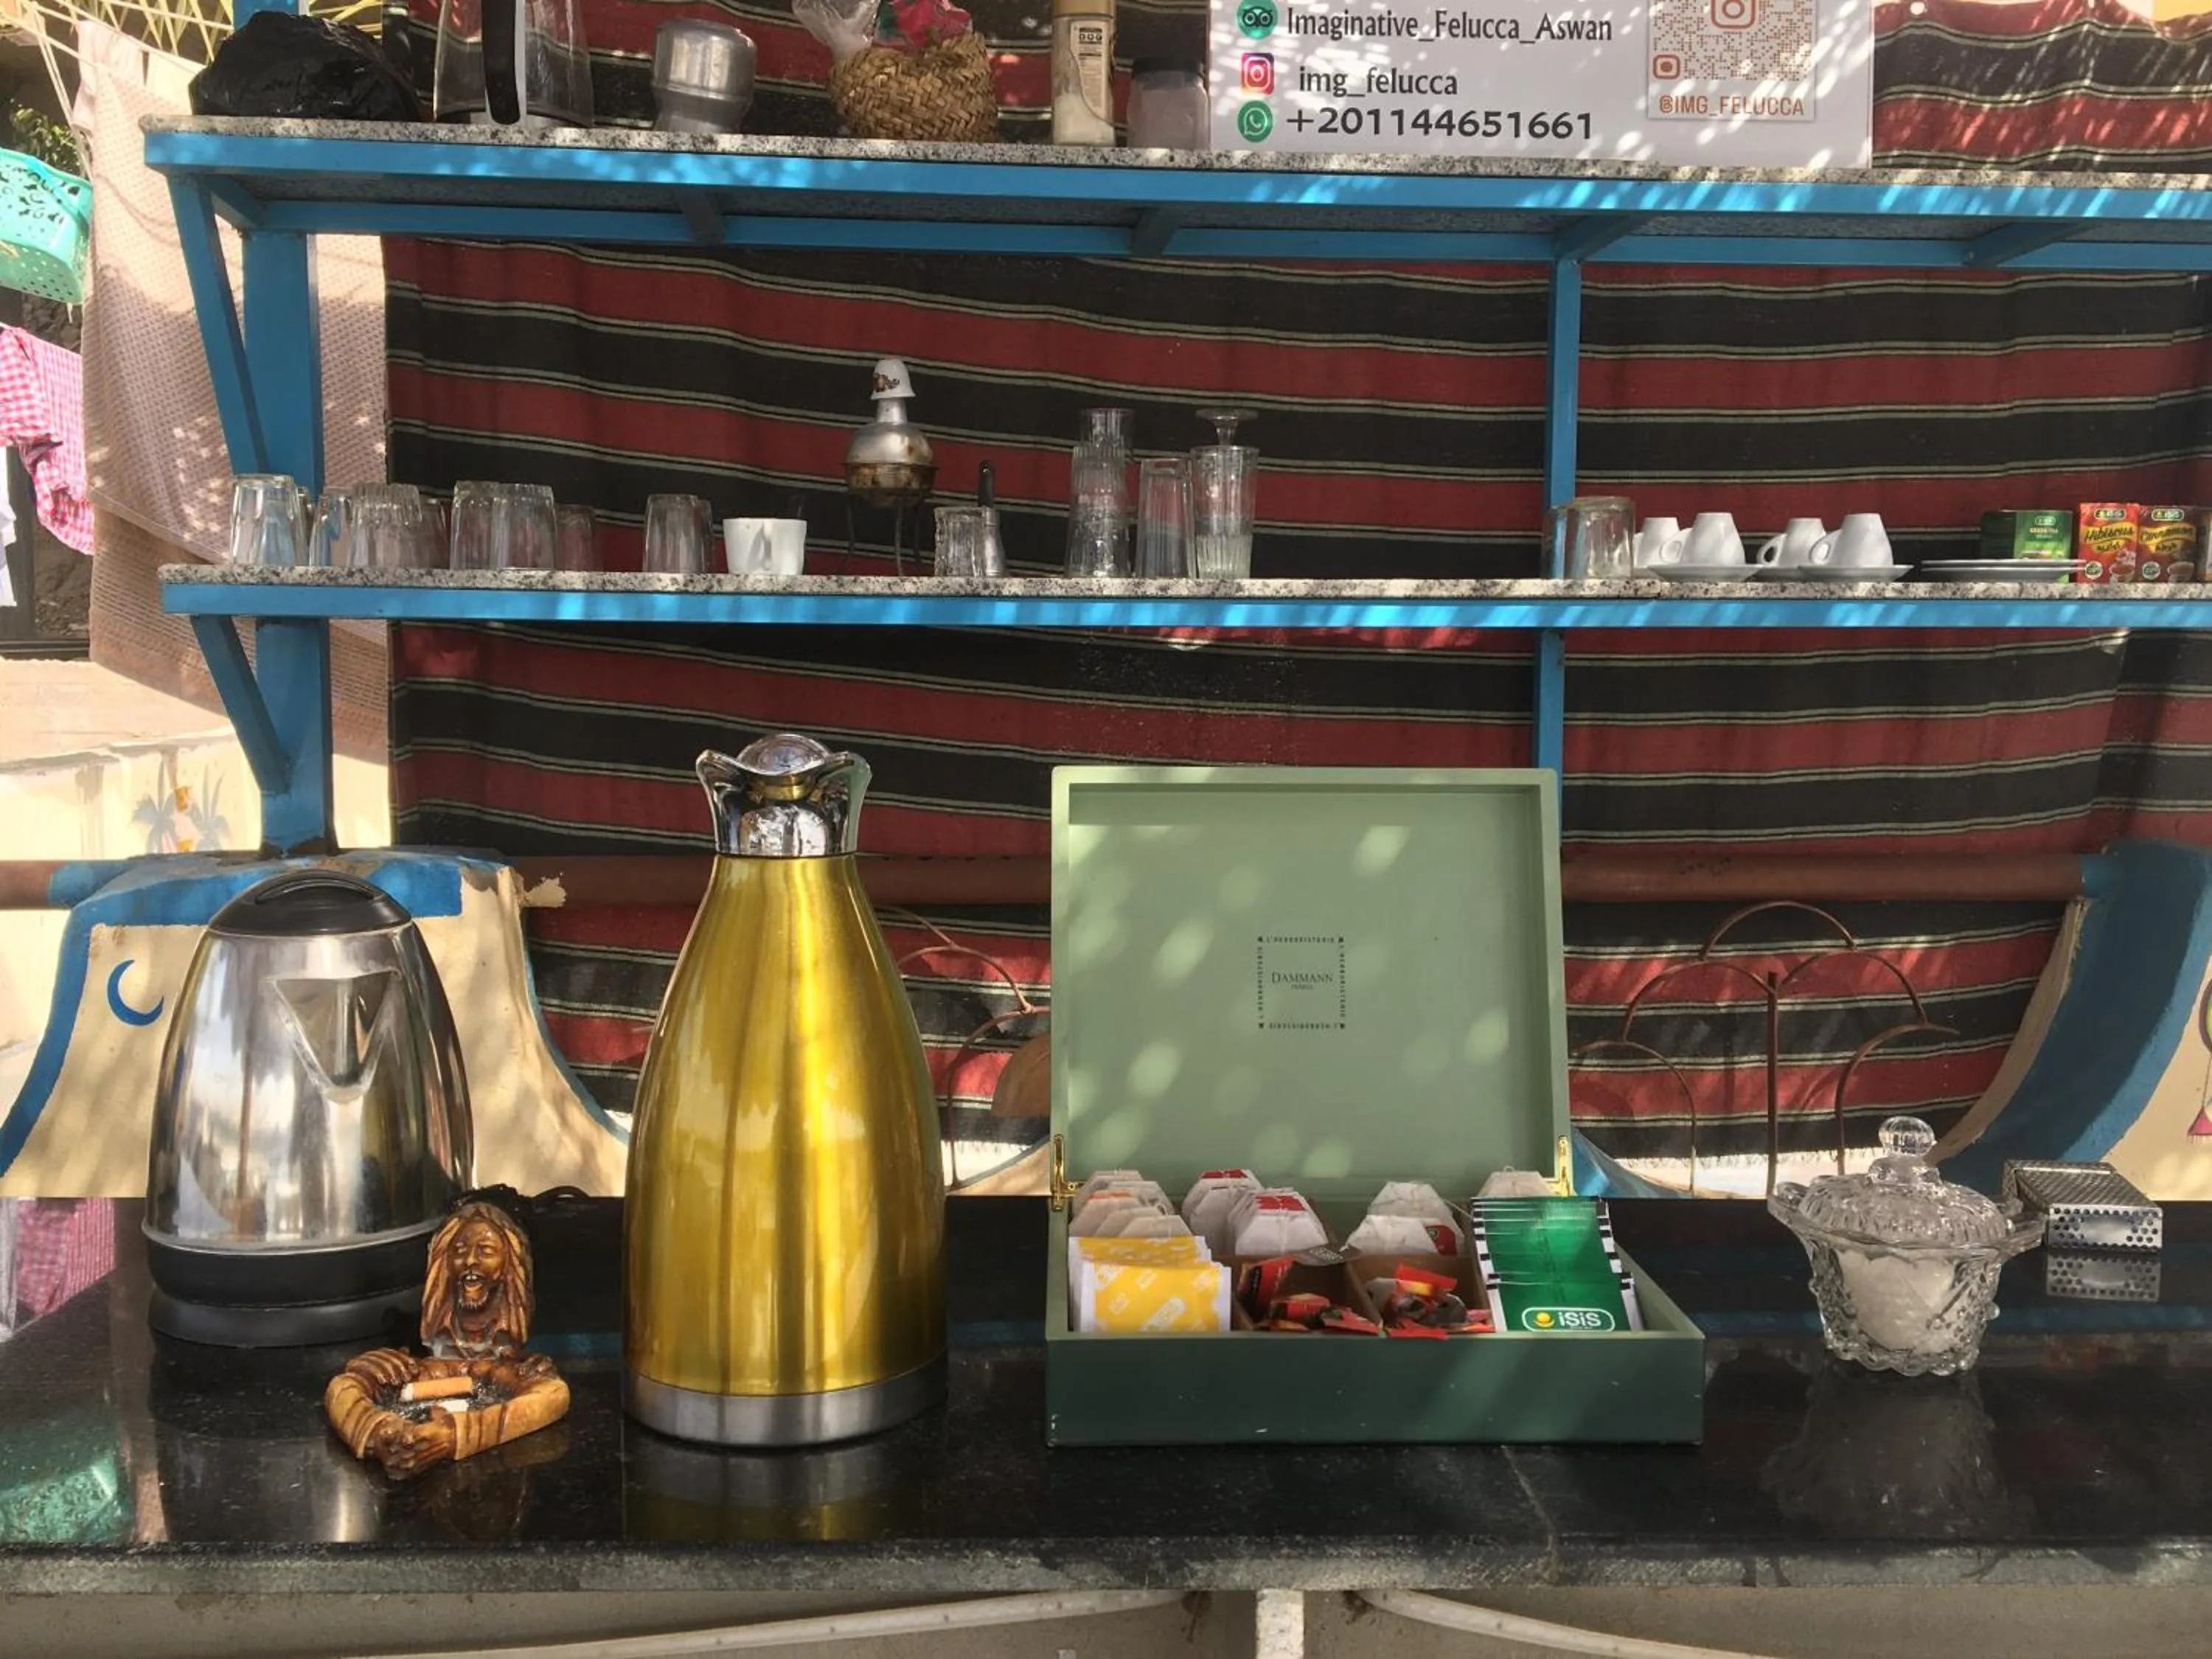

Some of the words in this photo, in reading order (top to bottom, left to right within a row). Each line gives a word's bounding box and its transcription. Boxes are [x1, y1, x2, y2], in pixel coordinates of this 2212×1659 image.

[1287, 7, 1613, 44] Imaginative_Felucca_Aswan
[1299, 66, 1458, 97] img_felucca
[1659, 94, 1805, 116] @IMG_FELUCCA
[1287, 108, 1592, 139] +201144651661
[1272, 972, 1333, 984] DAMMANN
